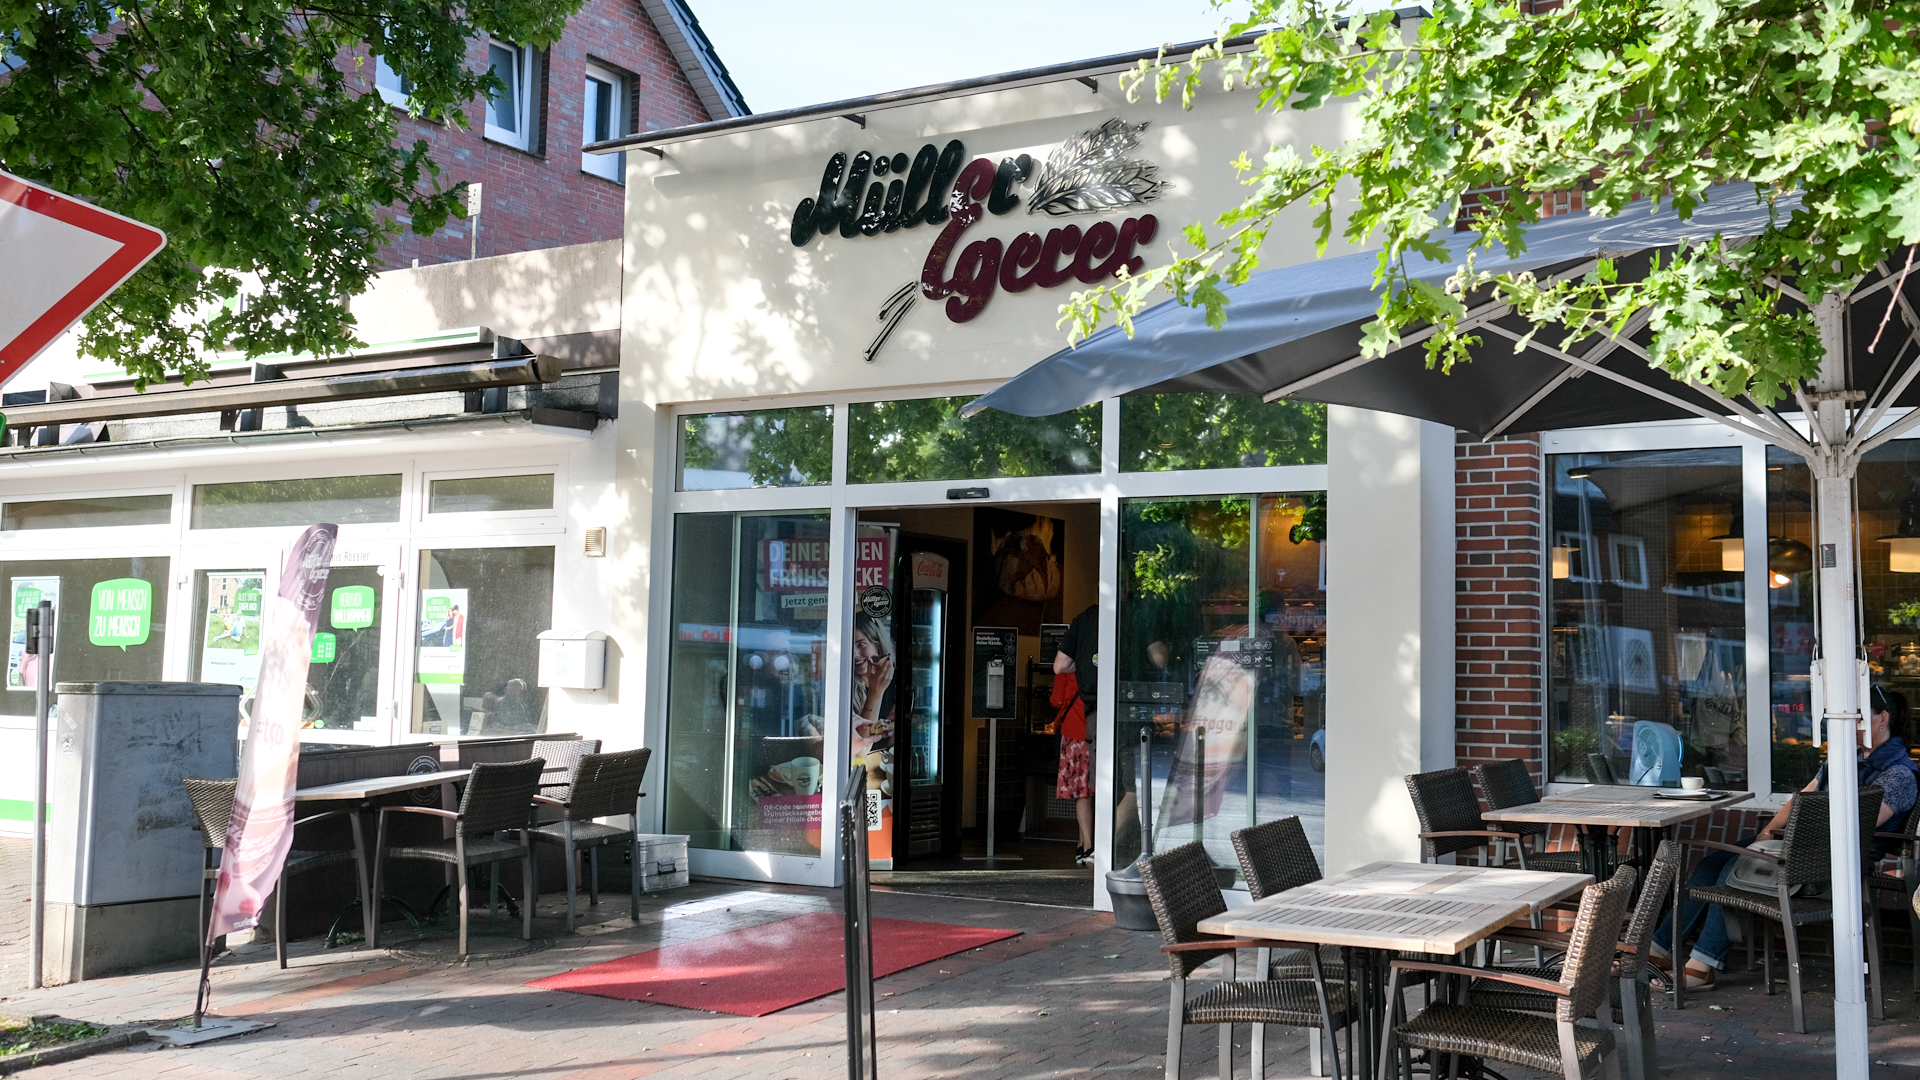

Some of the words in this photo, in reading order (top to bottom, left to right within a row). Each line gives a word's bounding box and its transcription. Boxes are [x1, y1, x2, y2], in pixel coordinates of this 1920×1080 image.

[790, 139, 1034, 247] Müller
[920, 158, 1159, 323] Egerer
[344, 550, 370, 562] Röseler
[769, 542, 821, 562] DEINE
[98, 589, 115, 611] VON
[117, 588, 148, 611] MENSCH
[784, 596, 807, 607] Jetzt
[808, 595, 828, 607] geni
[94, 615, 107, 637] ZU
[108, 615, 141, 638] MENSCH
[763, 810, 822, 818] Frühstücksangebo
